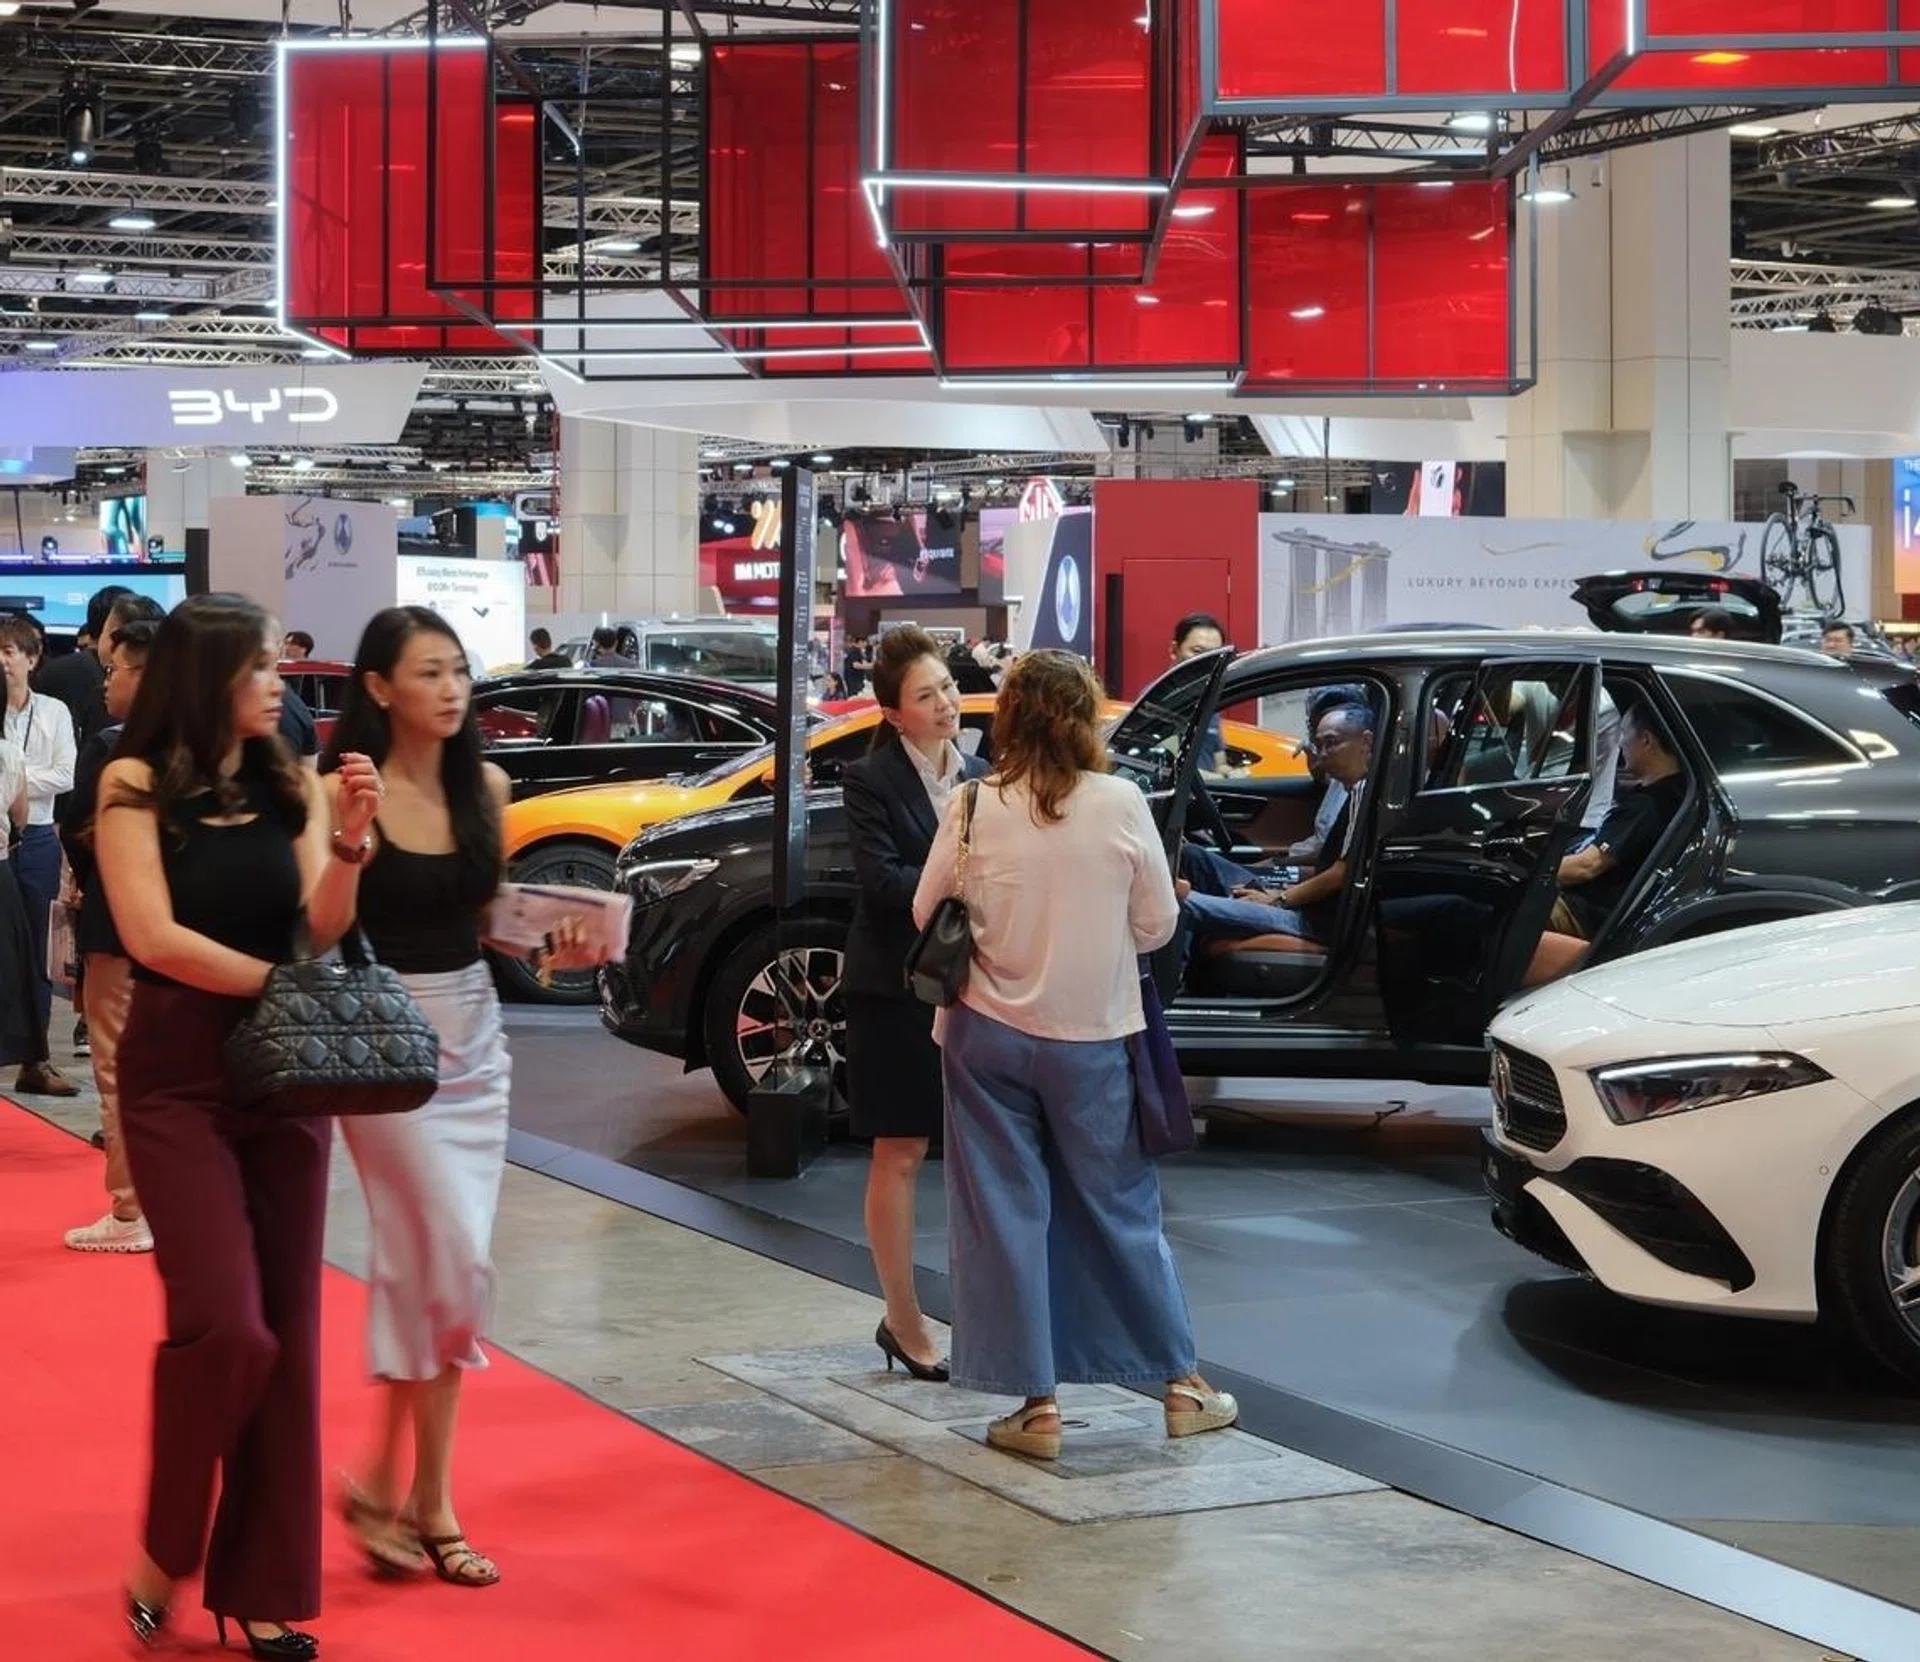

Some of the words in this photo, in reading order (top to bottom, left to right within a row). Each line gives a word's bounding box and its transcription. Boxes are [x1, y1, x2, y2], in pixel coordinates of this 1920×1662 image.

[168, 386, 338, 425] BYD
[1407, 577, 1462, 588] LUXURY
[1470, 577, 1528, 588] BEYOND
